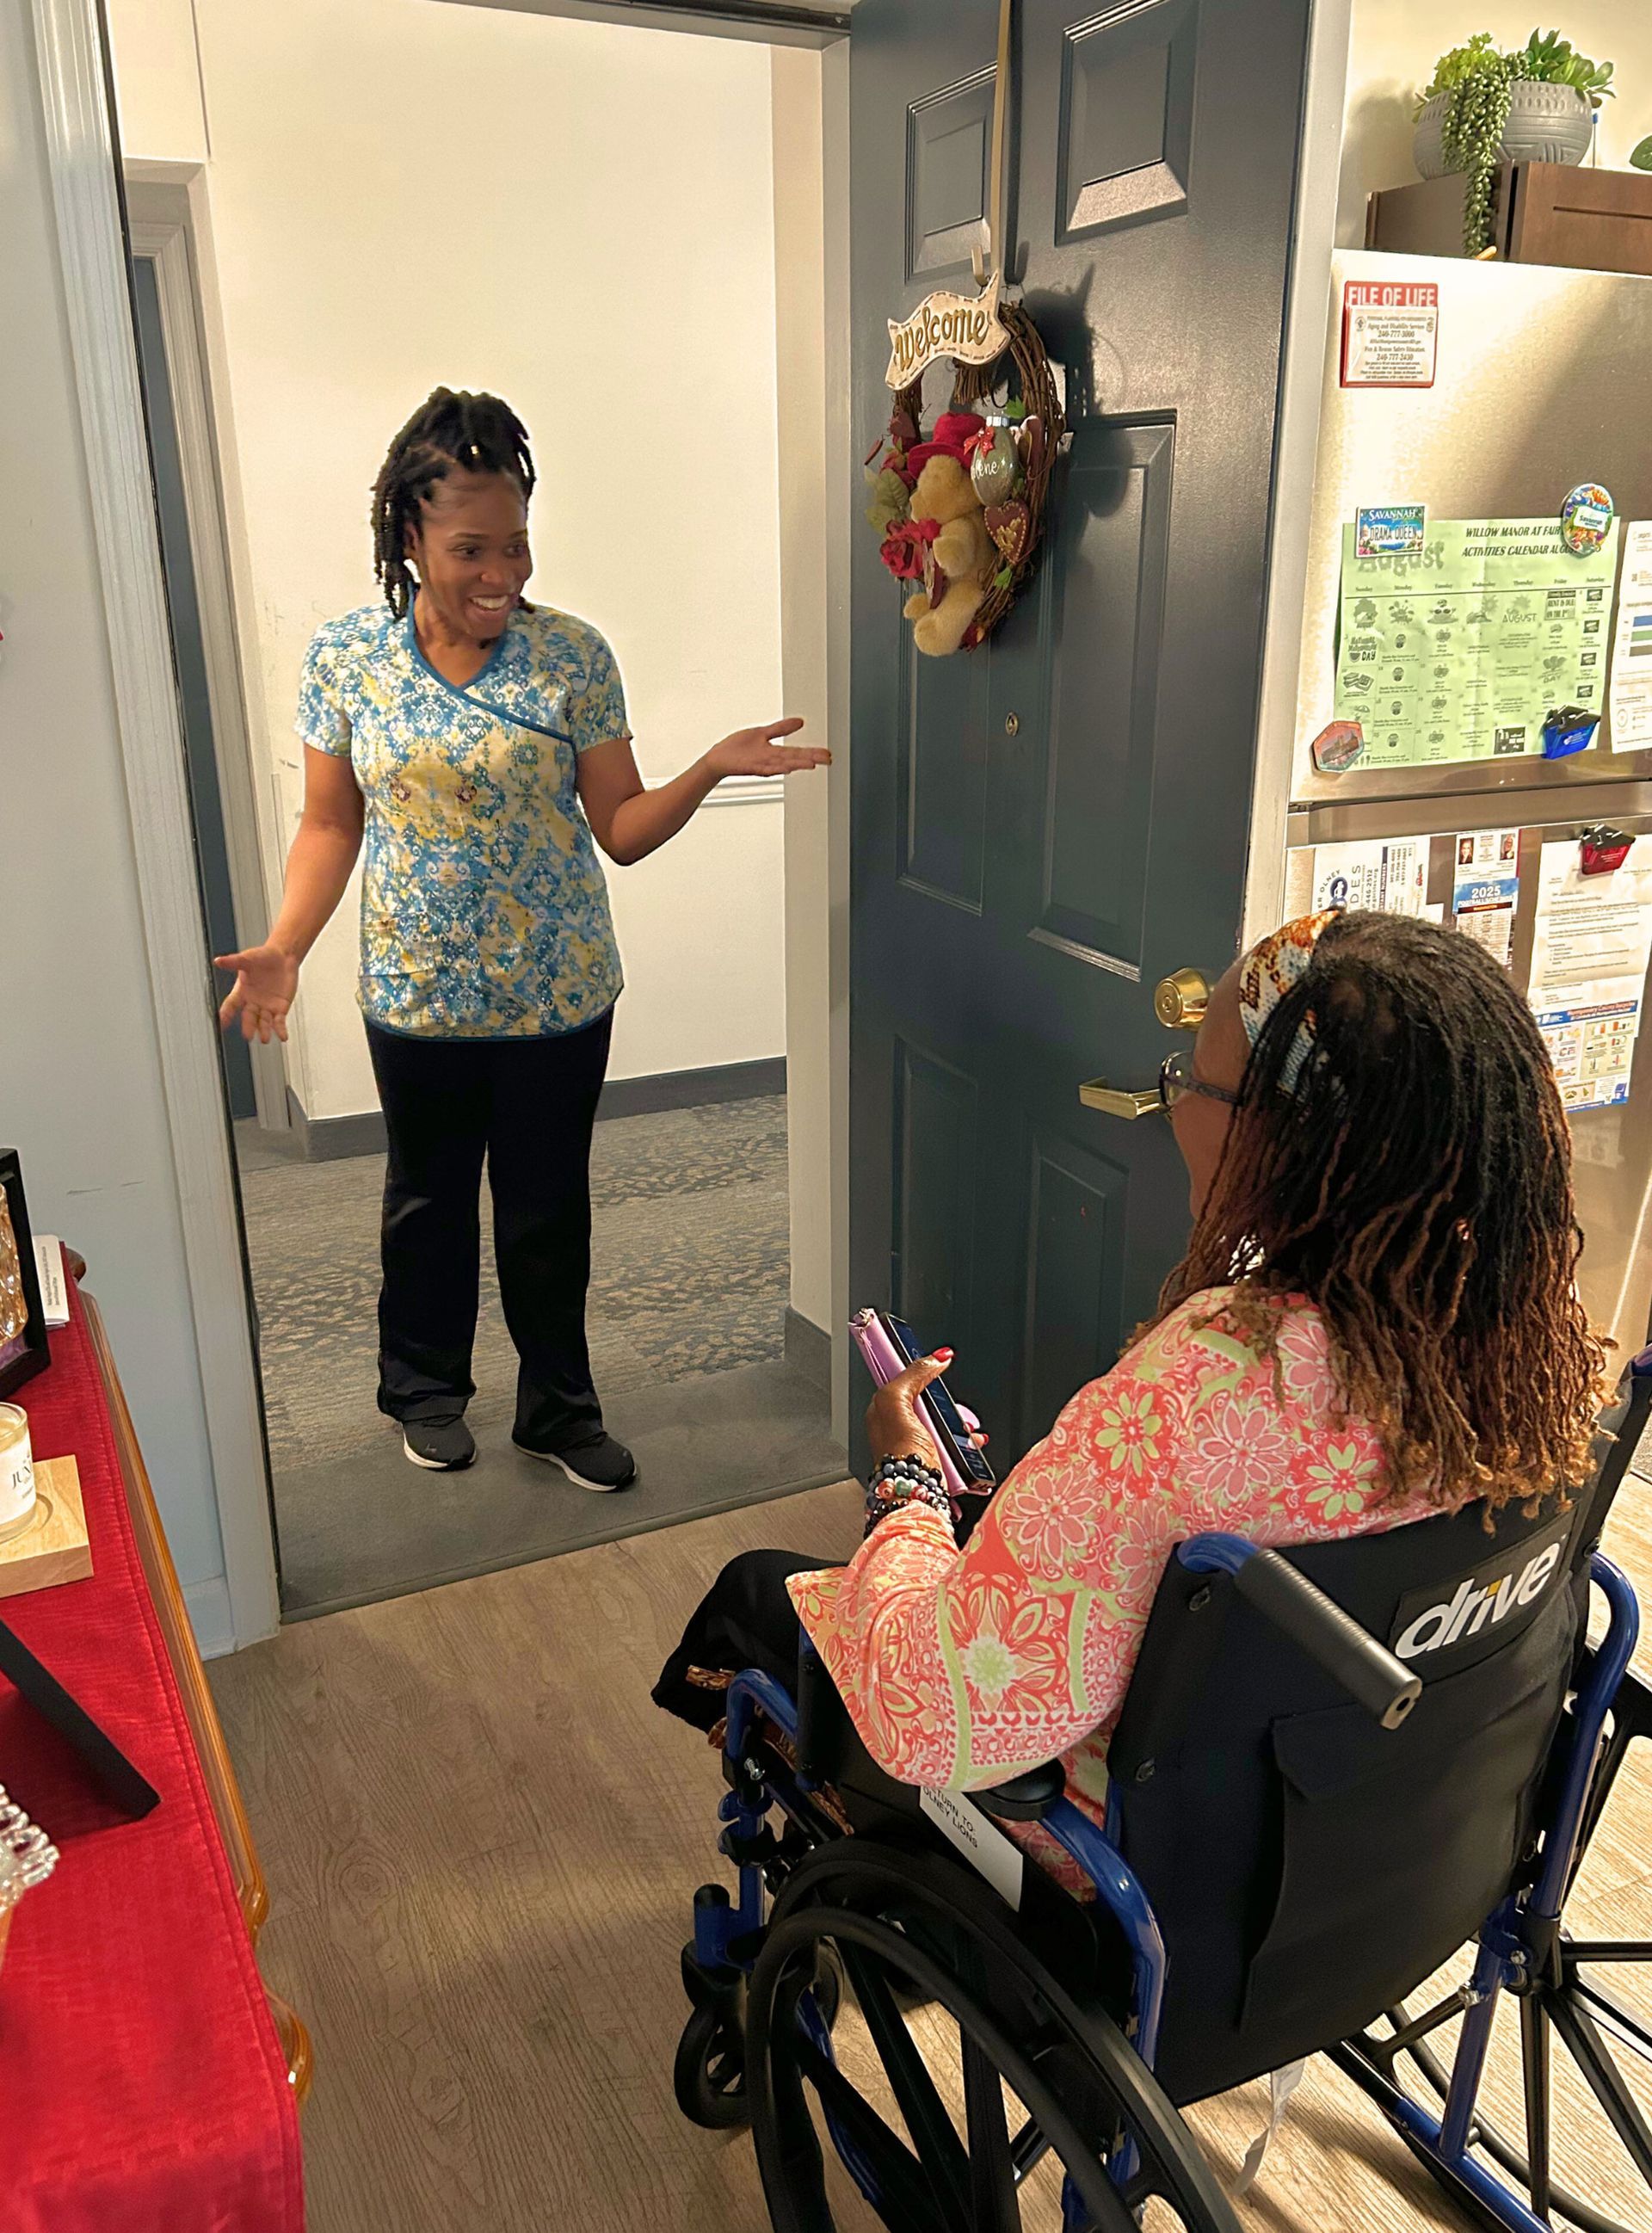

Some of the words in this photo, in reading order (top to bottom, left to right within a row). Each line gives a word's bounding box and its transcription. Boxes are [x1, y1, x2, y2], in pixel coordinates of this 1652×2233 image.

[1348, 286, 1378, 305] FILE
[1383, 287, 1402, 306] OF
[1406, 288, 1435, 307] LIFE
[1369, 509, 1416, 521] SAVANNAH
[1371, 527, 1391, 540] DRAMA
[1396, 525, 1417, 540] QUEEN
[1466, 527, 1499, 537] WILLOW
[1500, 527, 1530, 537] MANOR
[1531, 527, 1543, 536] AT
[1543, 526, 1563, 536] FAIR
[1462, 546, 1507, 557] ACTIVITIES
[1507, 546, 1549, 556] CALENDAR
[1502, 613, 1537, 623] AUGUST
[1320, 869, 1341, 893] OLNEY
[1471, 885, 1501, 899] 2025
[1395, 1543, 1560, 1659] drive
[931, 1787, 959, 1817] TURN
[922, 1786, 950, 1817] OLNEY
[952, 1817, 978, 1848] LIONS
